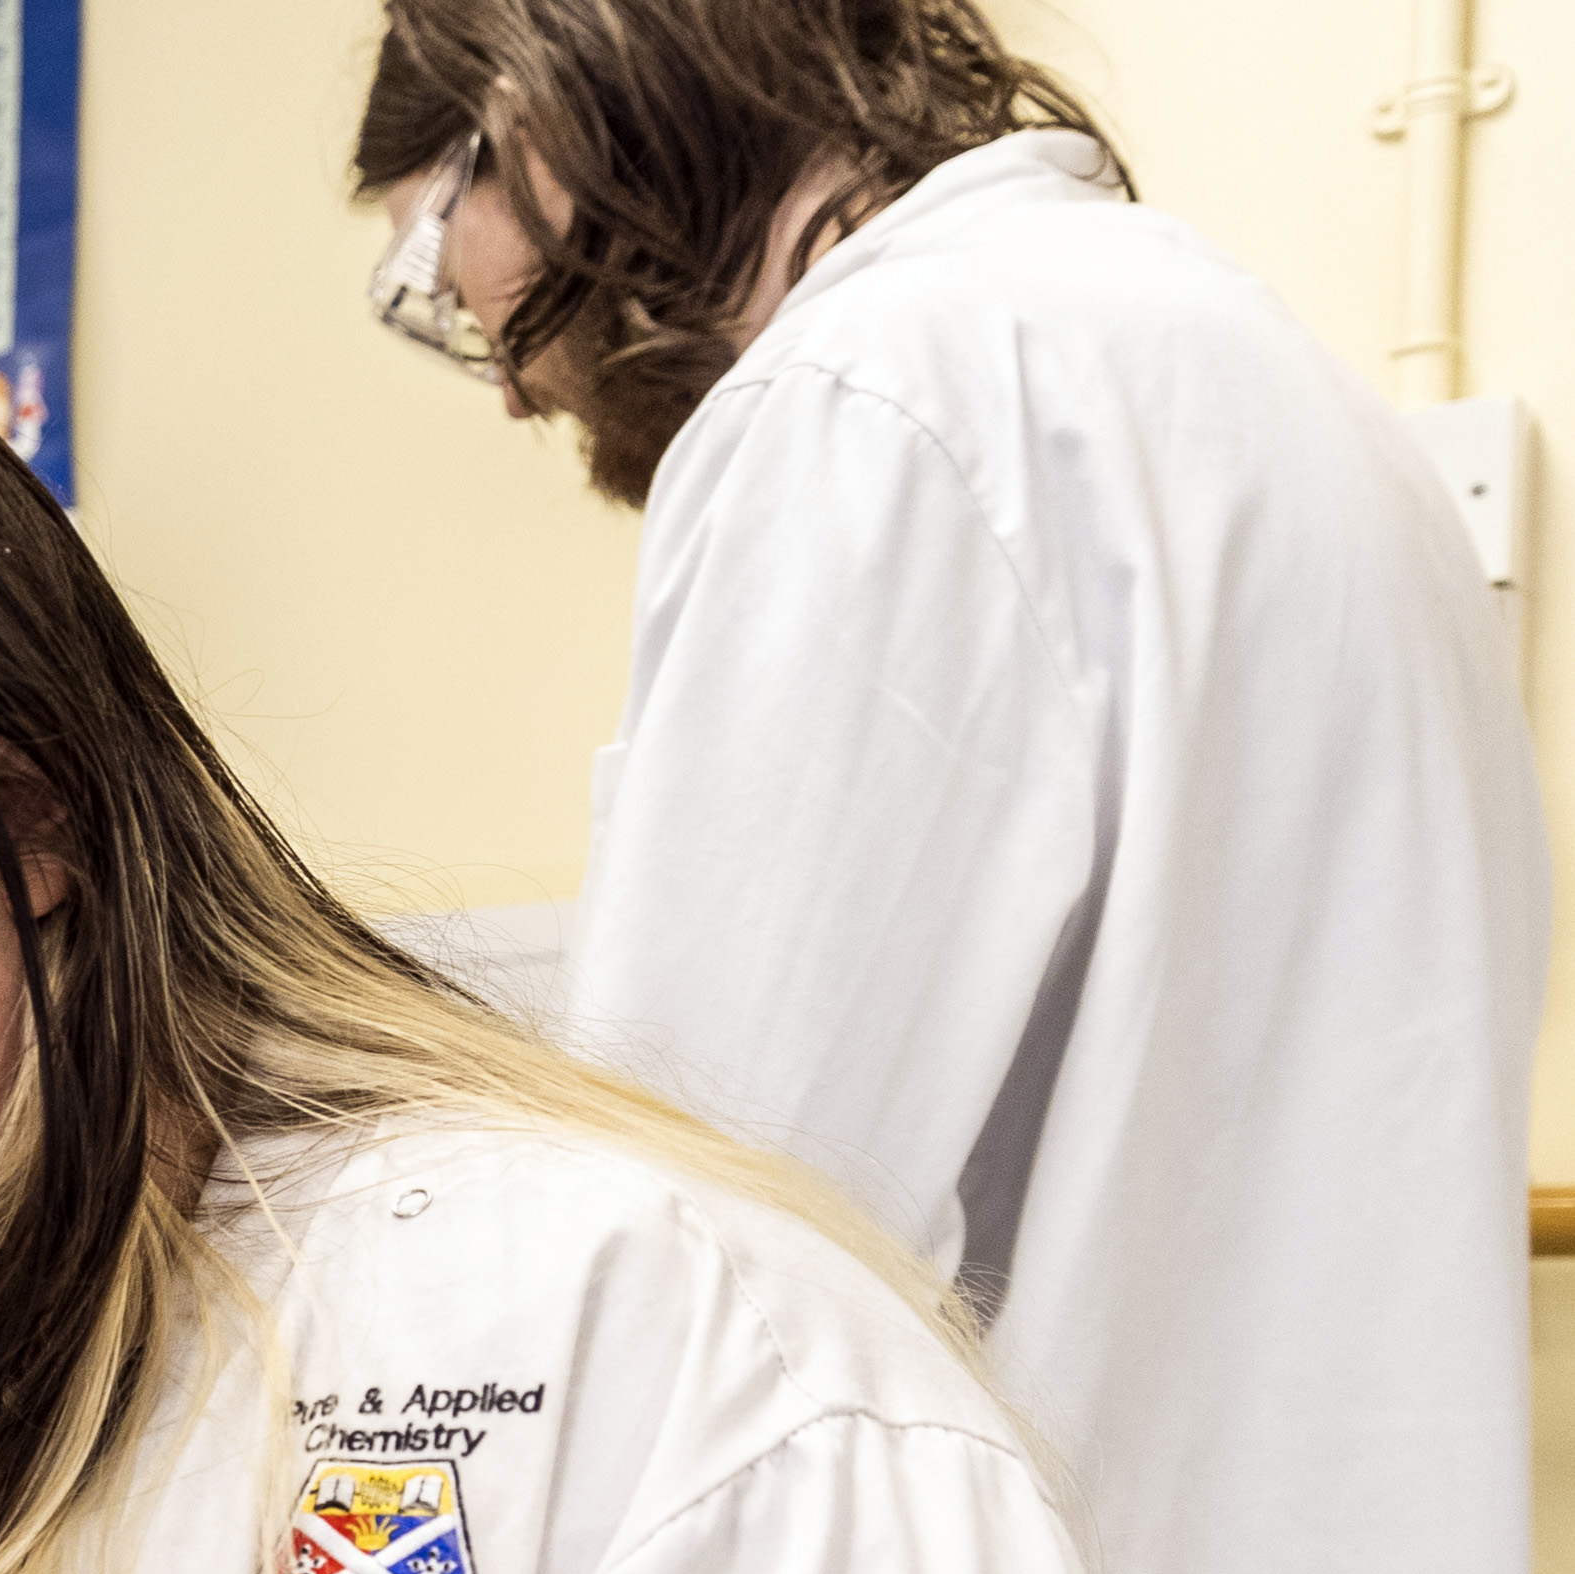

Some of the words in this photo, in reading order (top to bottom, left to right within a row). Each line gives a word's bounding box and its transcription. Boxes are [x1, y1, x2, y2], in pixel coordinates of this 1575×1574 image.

[358, 1386, 383, 1415] &
[401, 1382, 545, 1418] Applied
[304, 1421, 487, 1457] Chemistry
